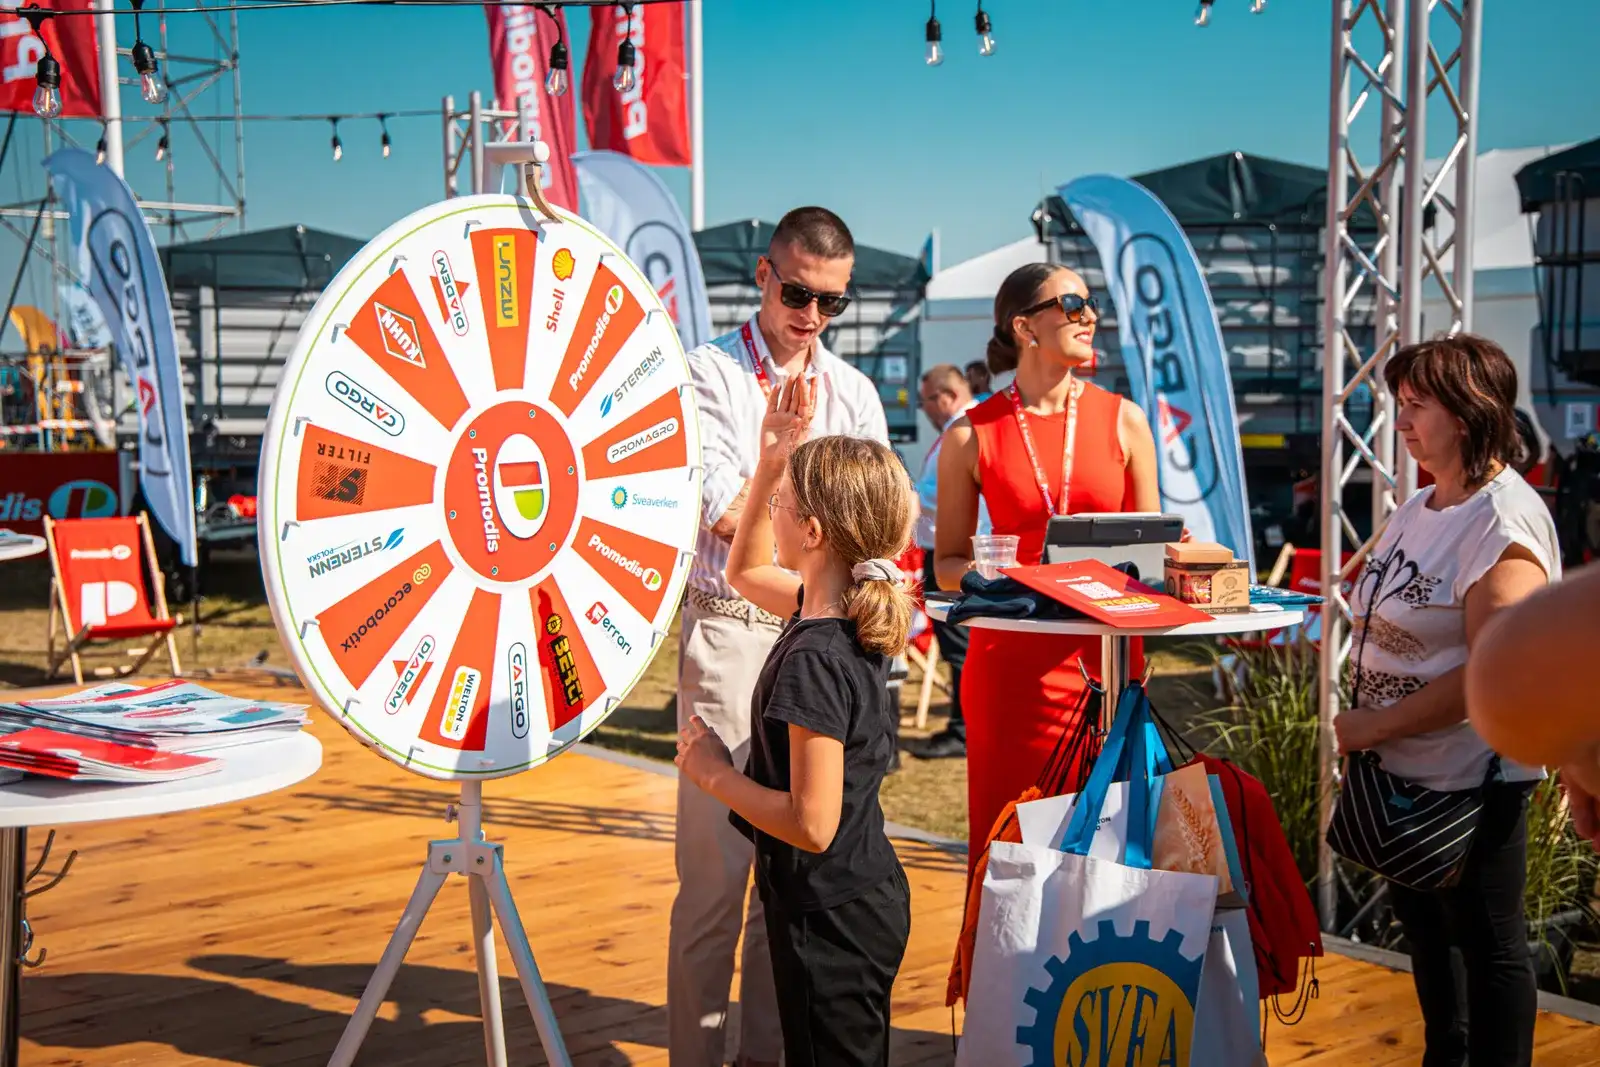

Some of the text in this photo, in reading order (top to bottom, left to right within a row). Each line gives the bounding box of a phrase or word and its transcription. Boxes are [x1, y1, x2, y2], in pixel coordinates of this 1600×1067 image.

[437, 256, 466, 332] DIADEM
[546, 289, 566, 333] Shell
[379, 309, 420, 362] KUHN
[568, 312, 611, 391] Promodis
[614, 346, 663, 401] STERENN
[335, 380, 396, 427] CARGO
[316, 442, 371, 464] FILTER
[611, 422, 675, 459] PROMAGRO
[471, 447, 500, 553] Promodis
[631, 494, 679, 509] Sveaverken
[306, 547, 335, 564] POLSKA
[309, 536, 383, 579] STERENN
[587, 534, 643, 577] Promodis
[340, 582, 412, 653] ecorobotix
[388, 641, 432, 709] DIADEM
[455, 673, 476, 724] WIELTON
[512, 653, 527, 730] CARGO
